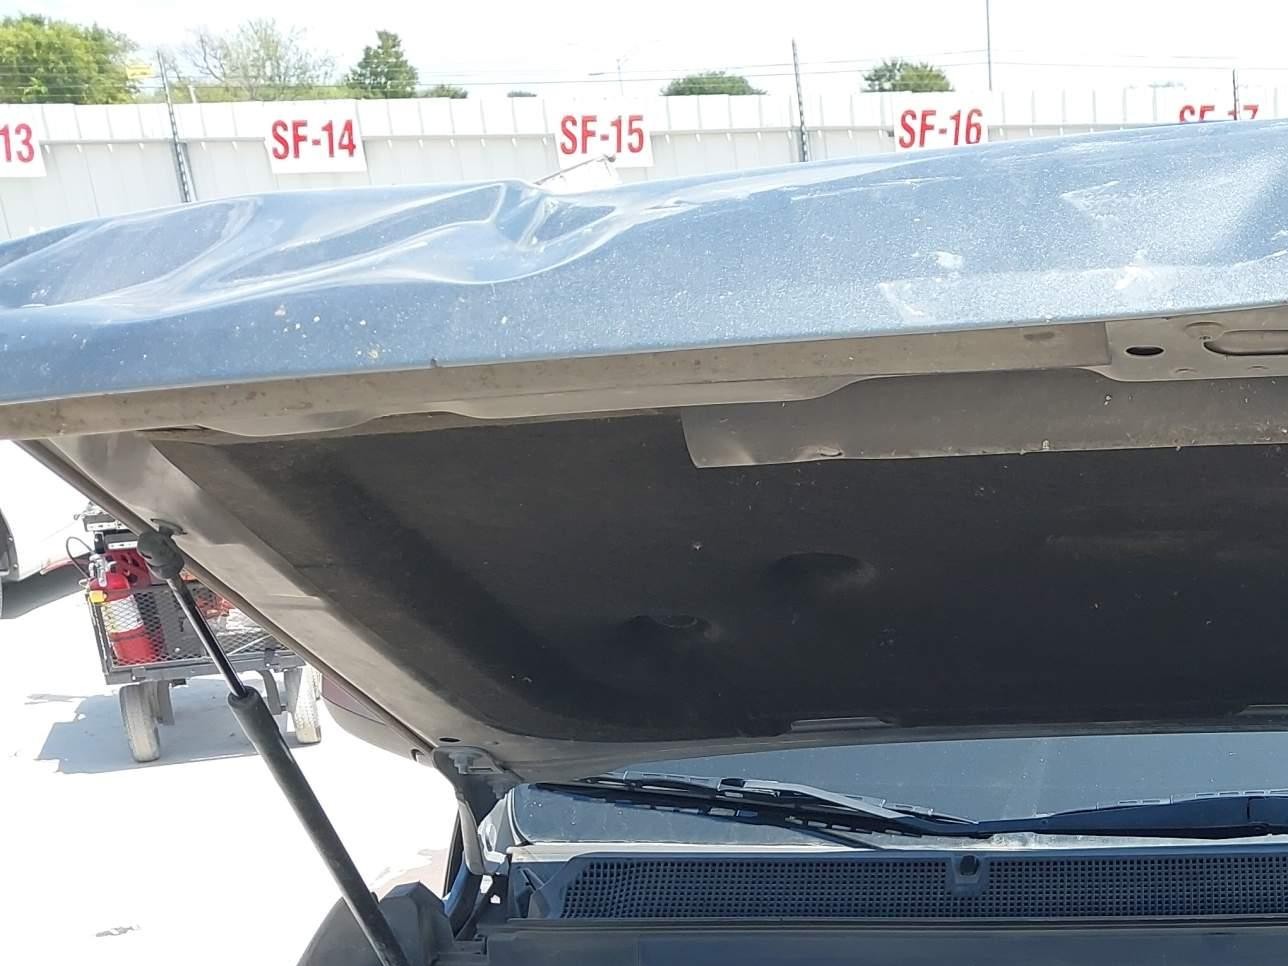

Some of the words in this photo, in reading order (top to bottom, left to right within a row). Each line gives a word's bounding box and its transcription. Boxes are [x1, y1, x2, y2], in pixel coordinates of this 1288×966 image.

[272, 119, 356, 160] SF-14
[560, 115, 644, 155] SF-15
[898, 108, 983, 149] SF-16
